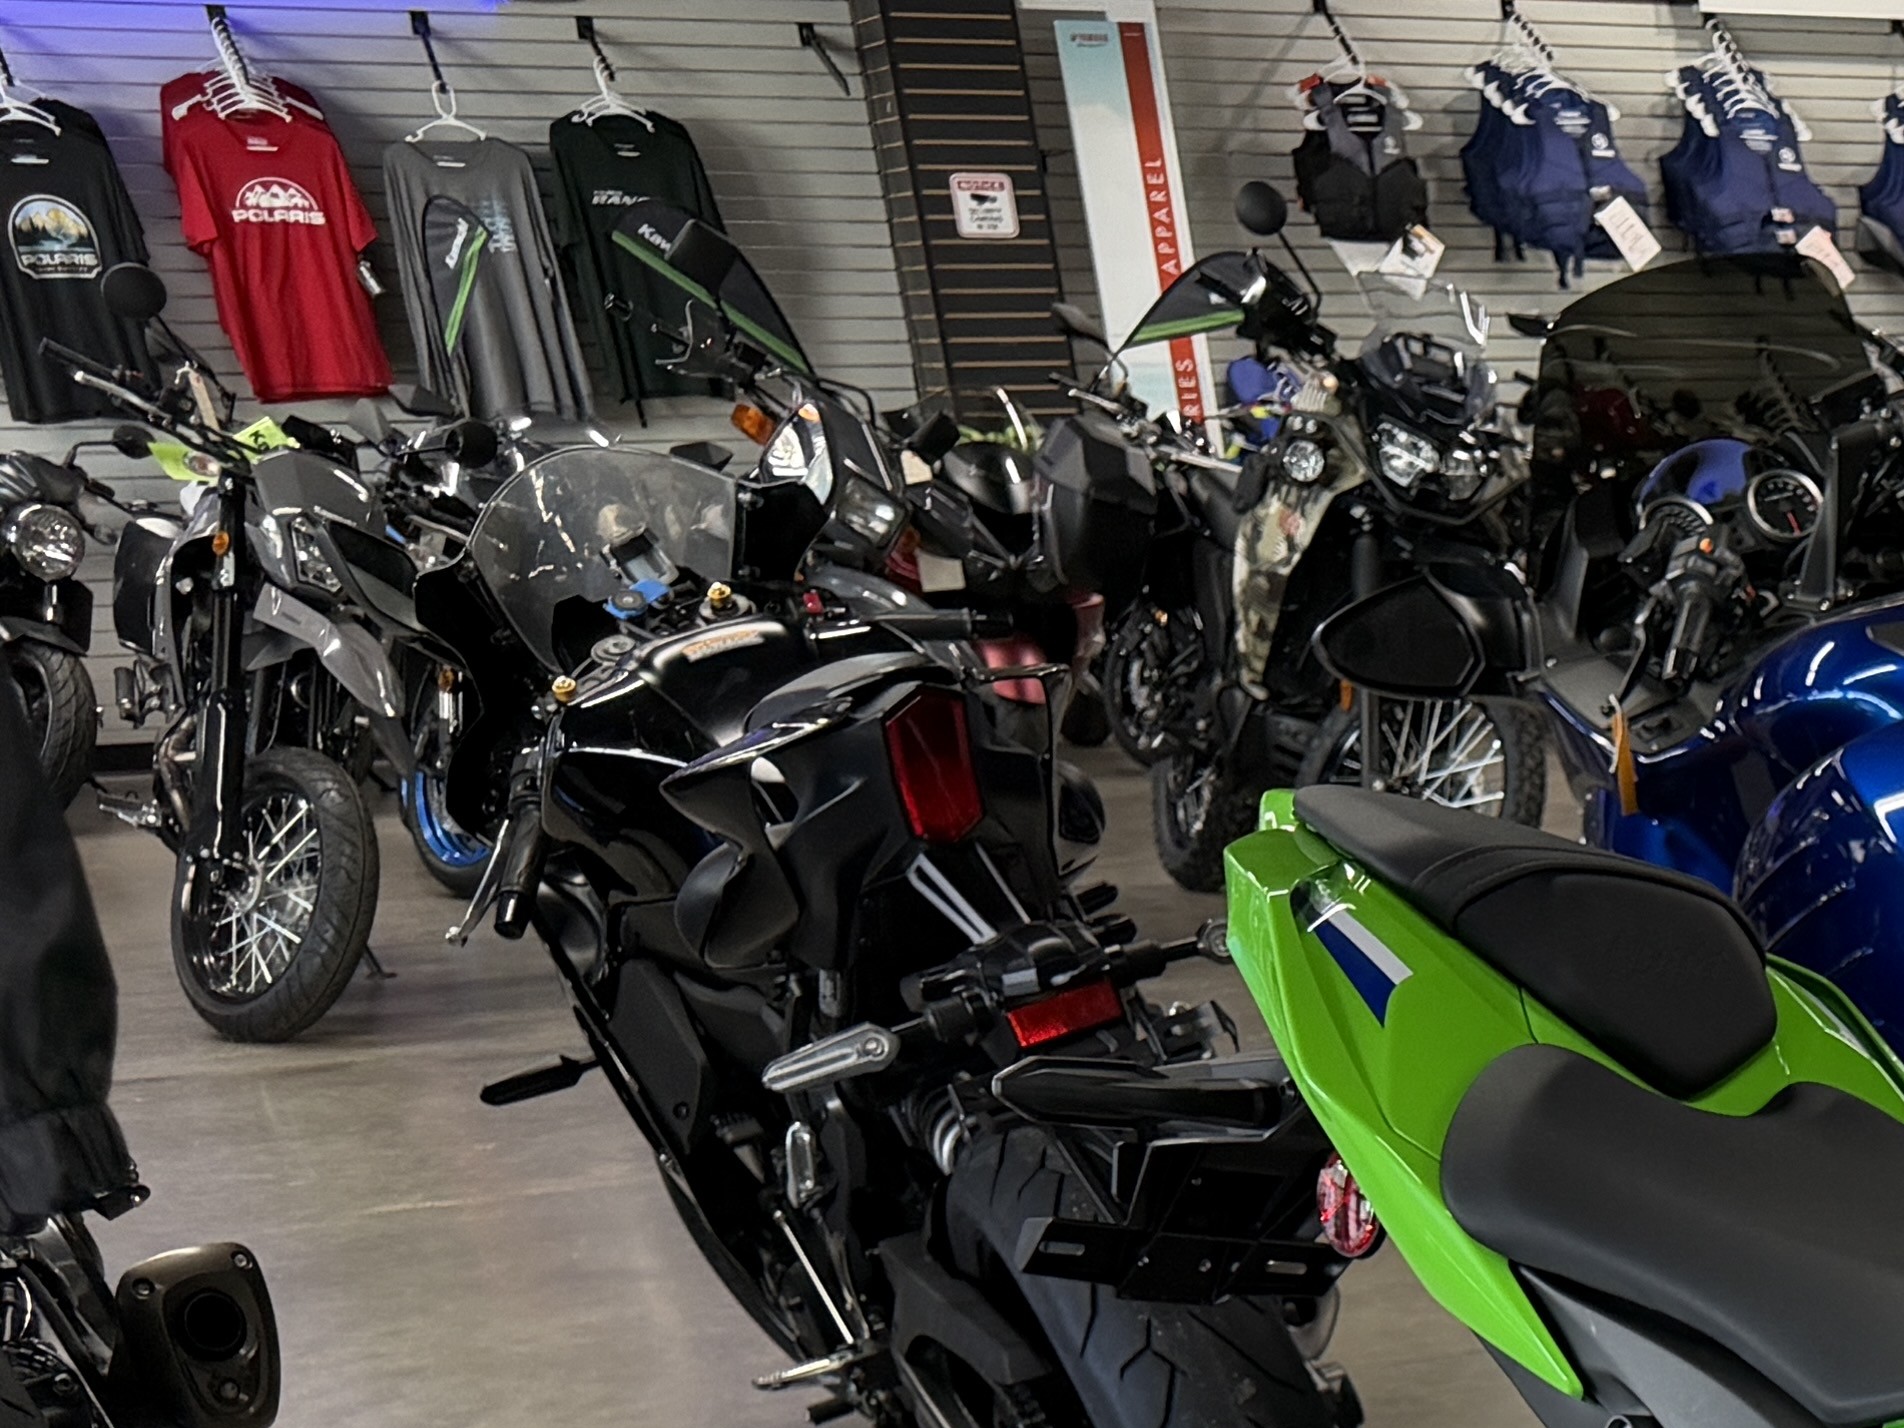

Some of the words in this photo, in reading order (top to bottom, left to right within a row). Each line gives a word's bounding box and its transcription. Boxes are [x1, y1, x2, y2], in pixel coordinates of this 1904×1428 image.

[232, 209, 326, 225] POLARIS
[1145, 158, 1181, 275] APPAREL
[21, 253, 98, 267] POLARIS
